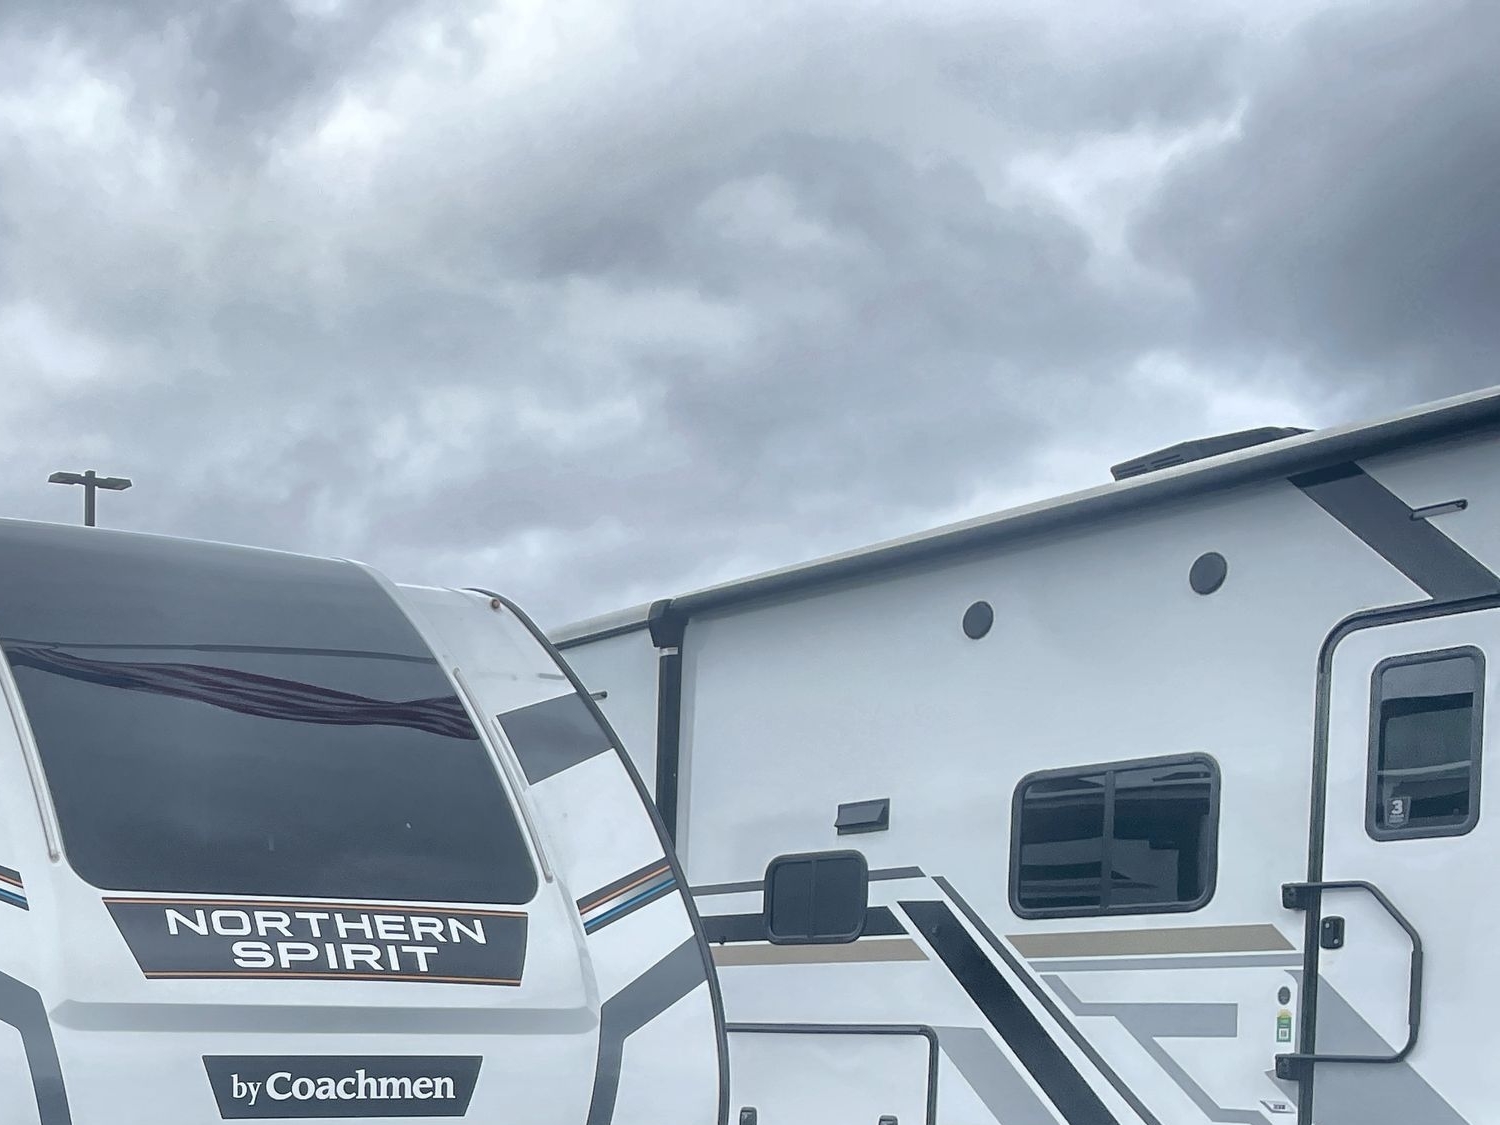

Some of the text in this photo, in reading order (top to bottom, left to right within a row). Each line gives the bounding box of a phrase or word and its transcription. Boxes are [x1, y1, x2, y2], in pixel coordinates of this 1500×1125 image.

[1391, 799, 1403, 815] 3
[165, 908, 487, 945] NORTHERN
[232, 941, 439, 972] SPIRIT
[231, 1069, 456, 1106] by Coachmen
